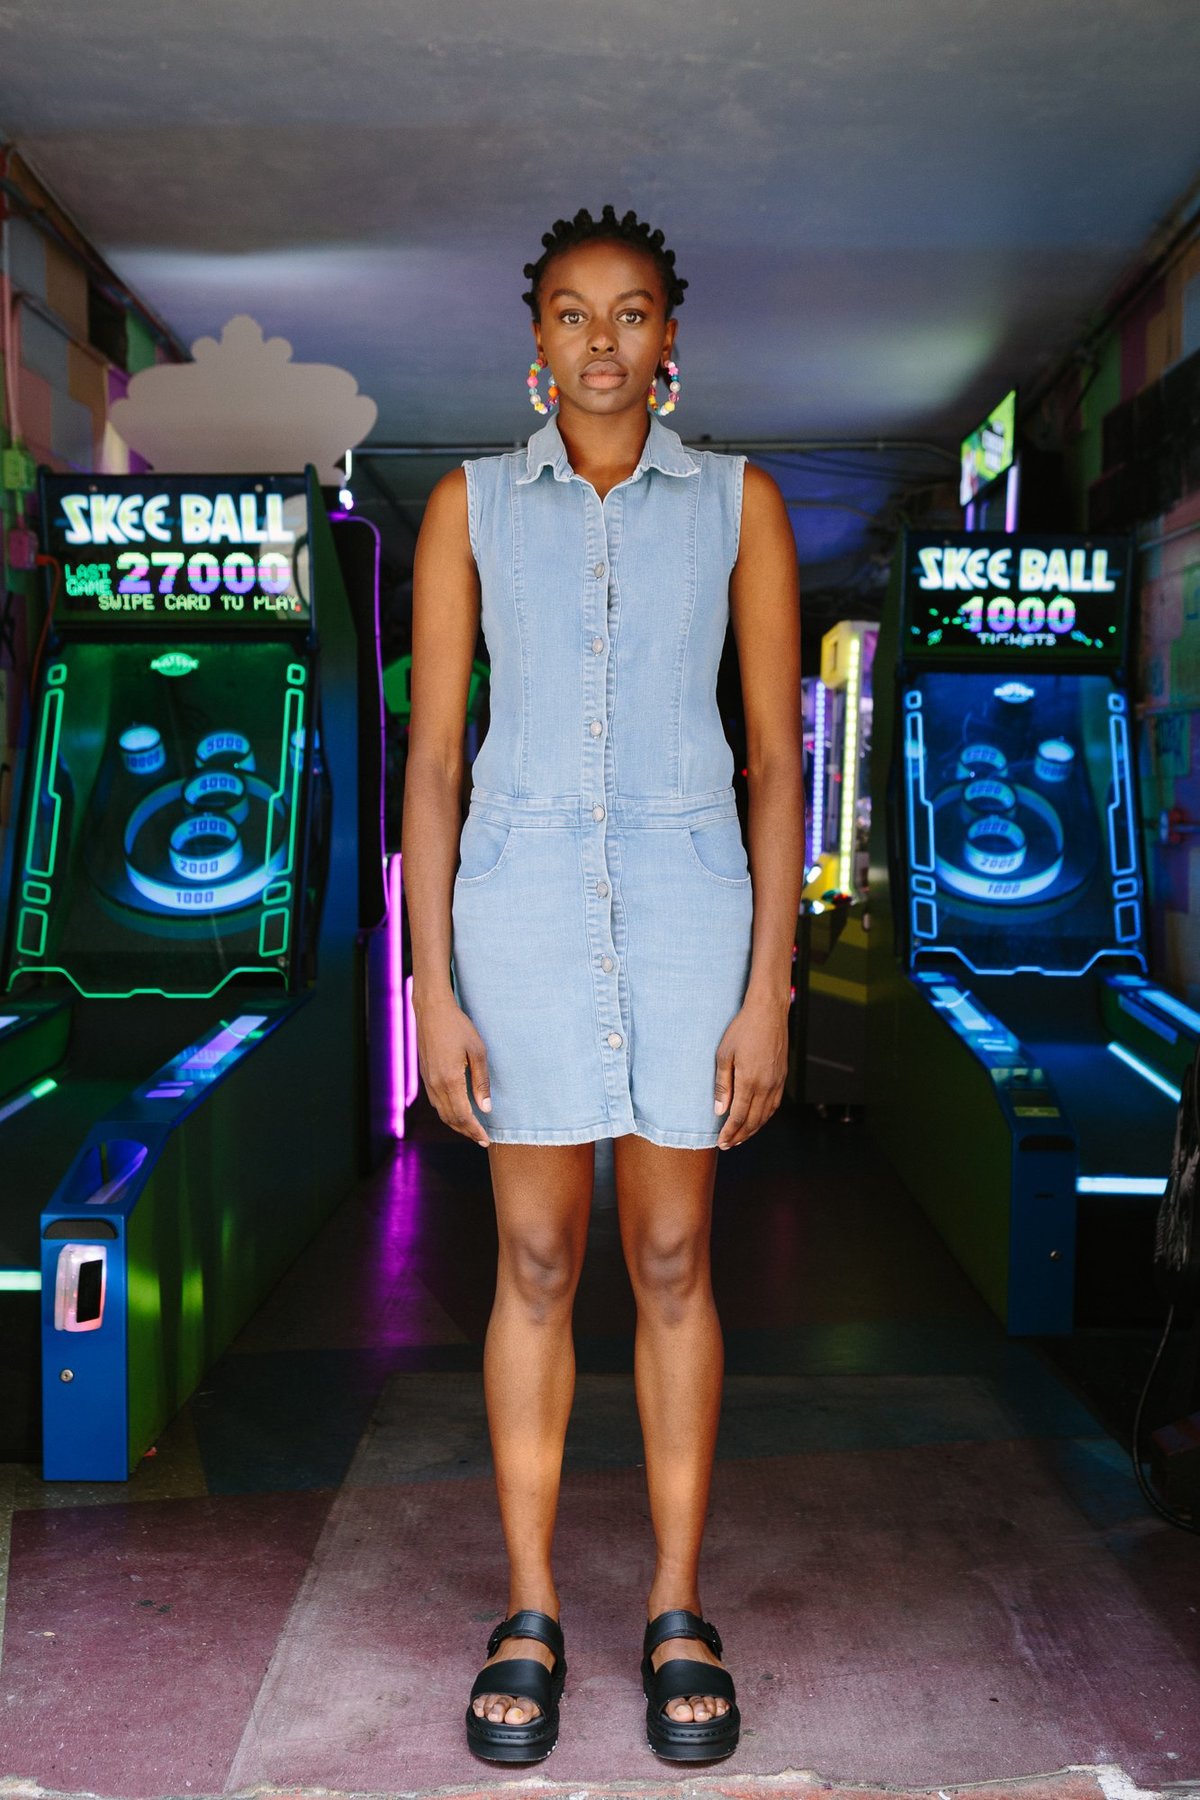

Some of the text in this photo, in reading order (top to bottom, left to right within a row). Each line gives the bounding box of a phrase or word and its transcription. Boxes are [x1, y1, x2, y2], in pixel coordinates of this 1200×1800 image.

[61, 494, 295, 544] SKEE BALL
[65, 564, 111, 579] LAST
[116, 552, 291, 594] 27000
[918, 547, 1116, 592] SKEE BALL
[65, 578, 112, 596] GAME
[98, 594, 155, 610] SWIPE
[164, 594, 211, 610] CARD
[960, 595, 1076, 634] 1000
[180, 859, 219, 874] 2000
[981, 857, 1016, 869] 2000
[987, 883, 1021, 894] 1000
[176, 890, 214, 904] 1000
